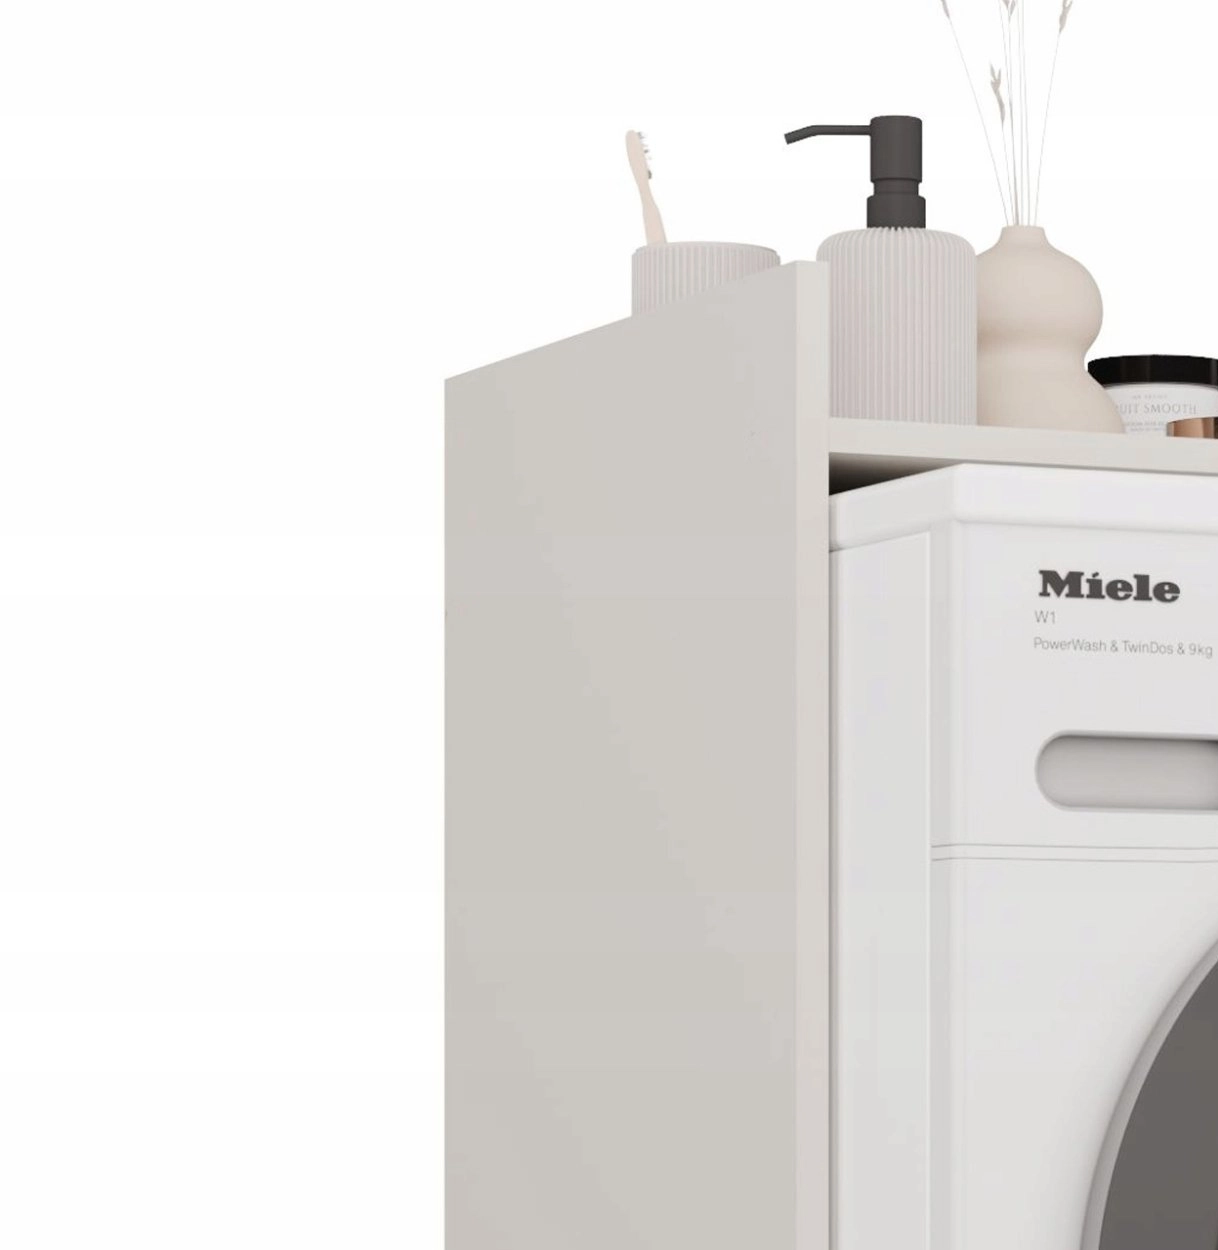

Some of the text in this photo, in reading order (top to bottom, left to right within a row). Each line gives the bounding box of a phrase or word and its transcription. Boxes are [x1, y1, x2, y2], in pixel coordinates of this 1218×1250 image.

[1143, 402, 1197, 415] SMOOTH
[1038, 569, 1181, 603] Miele
[1034, 610, 1056, 624] W1
[1033, 637, 1213, 659] PowerWash & TwinDos & 9kg
